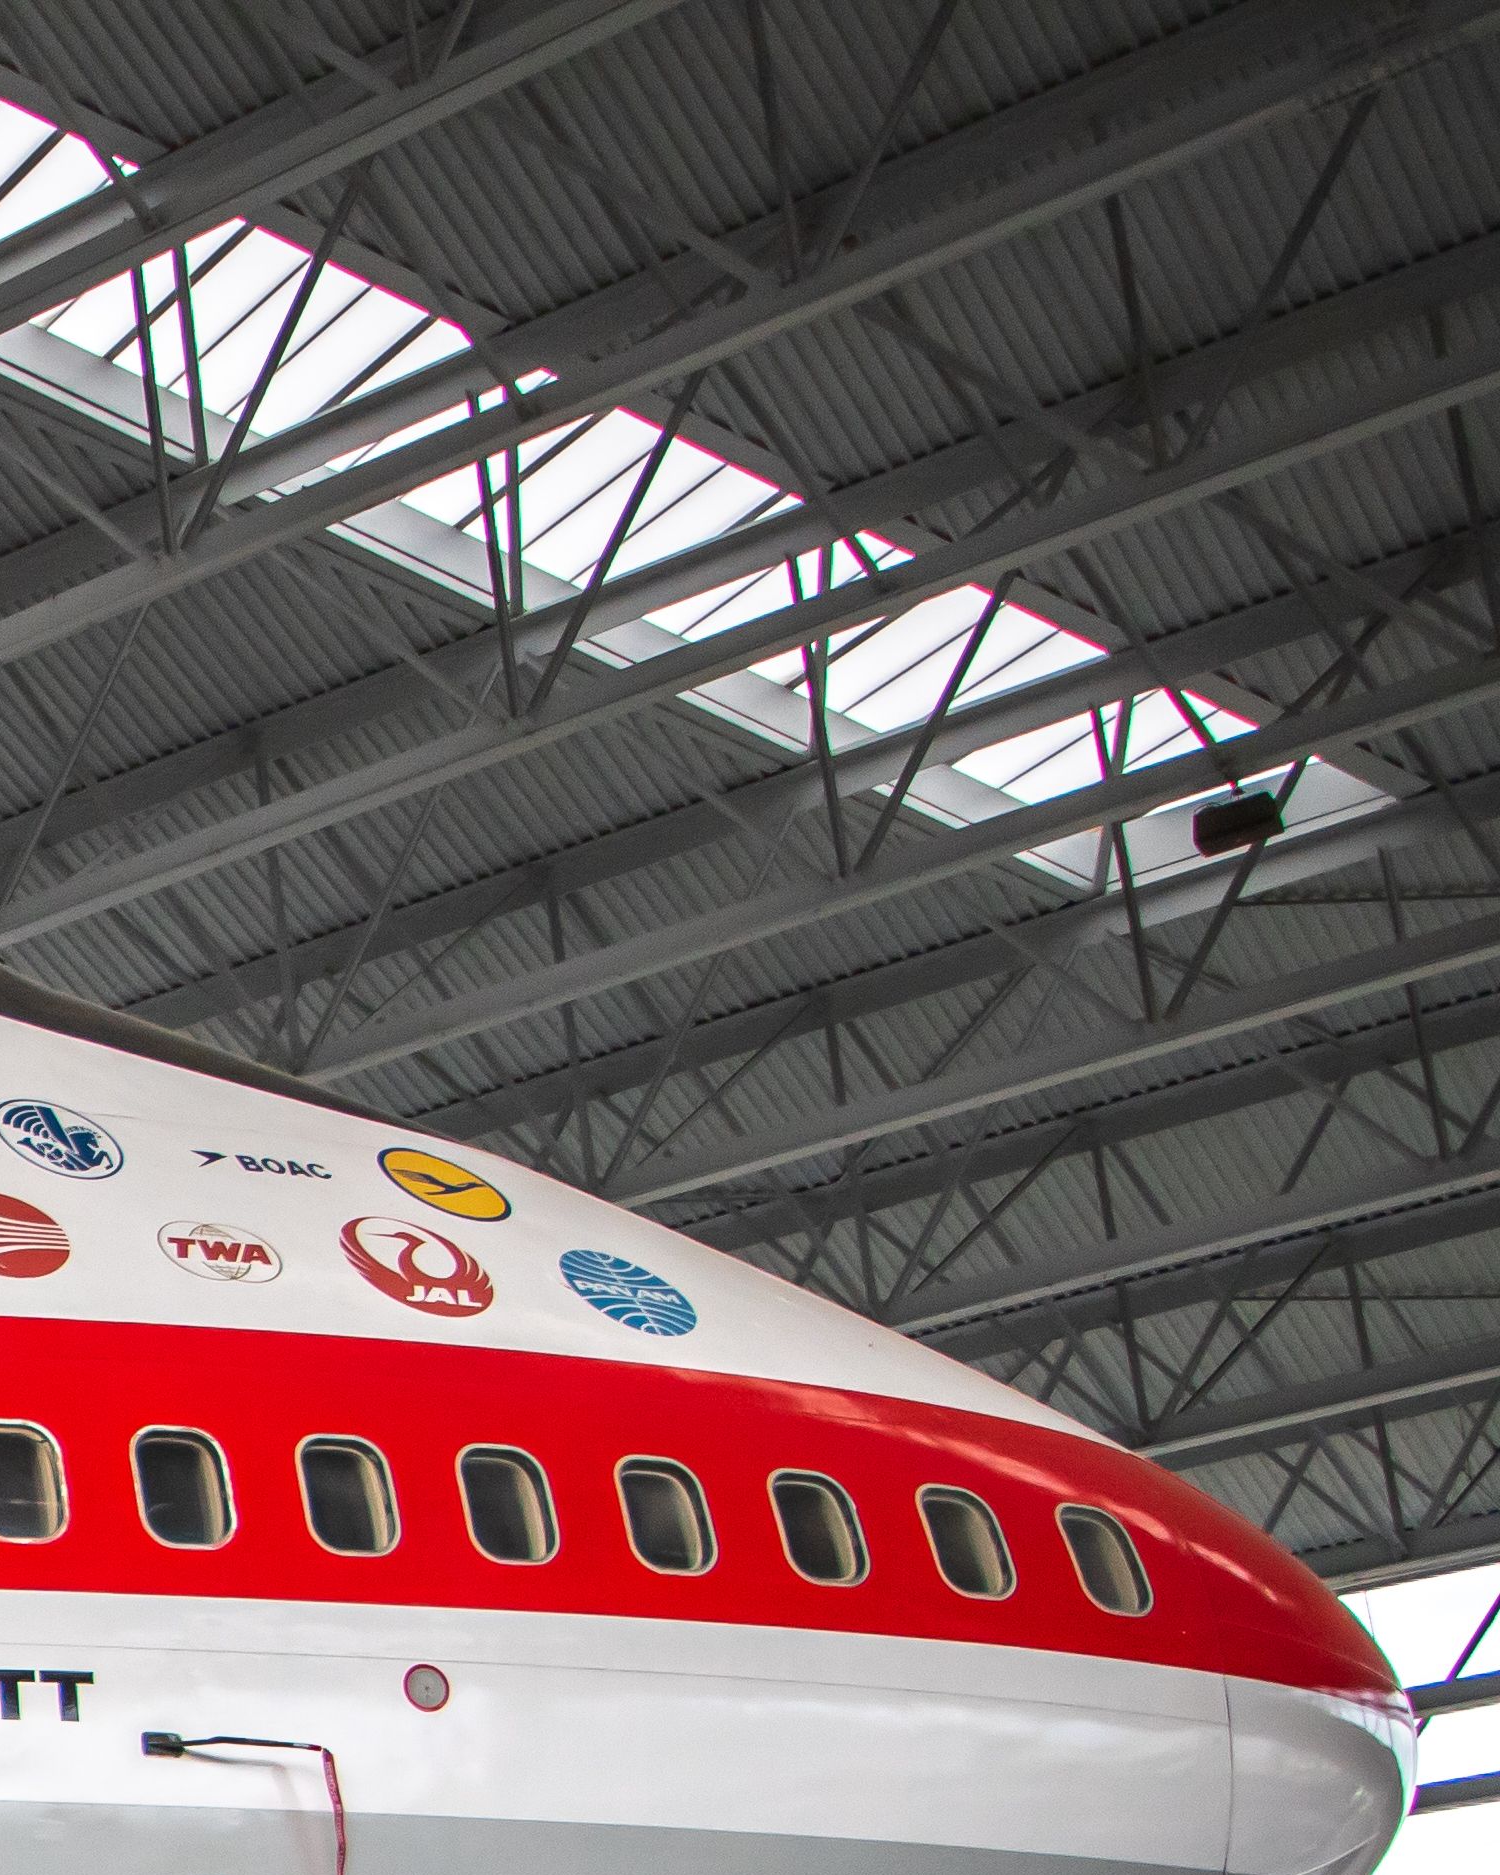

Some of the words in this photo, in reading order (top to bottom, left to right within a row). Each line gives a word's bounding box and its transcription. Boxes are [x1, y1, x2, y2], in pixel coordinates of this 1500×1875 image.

[235, 1154, 333, 1180] BOAC
[167, 1237, 272, 1266] TWA
[405, 1285, 482, 1307] JAL
[572, 1279, 633, 1297] PAN
[637, 1289, 682, 1305] AM
